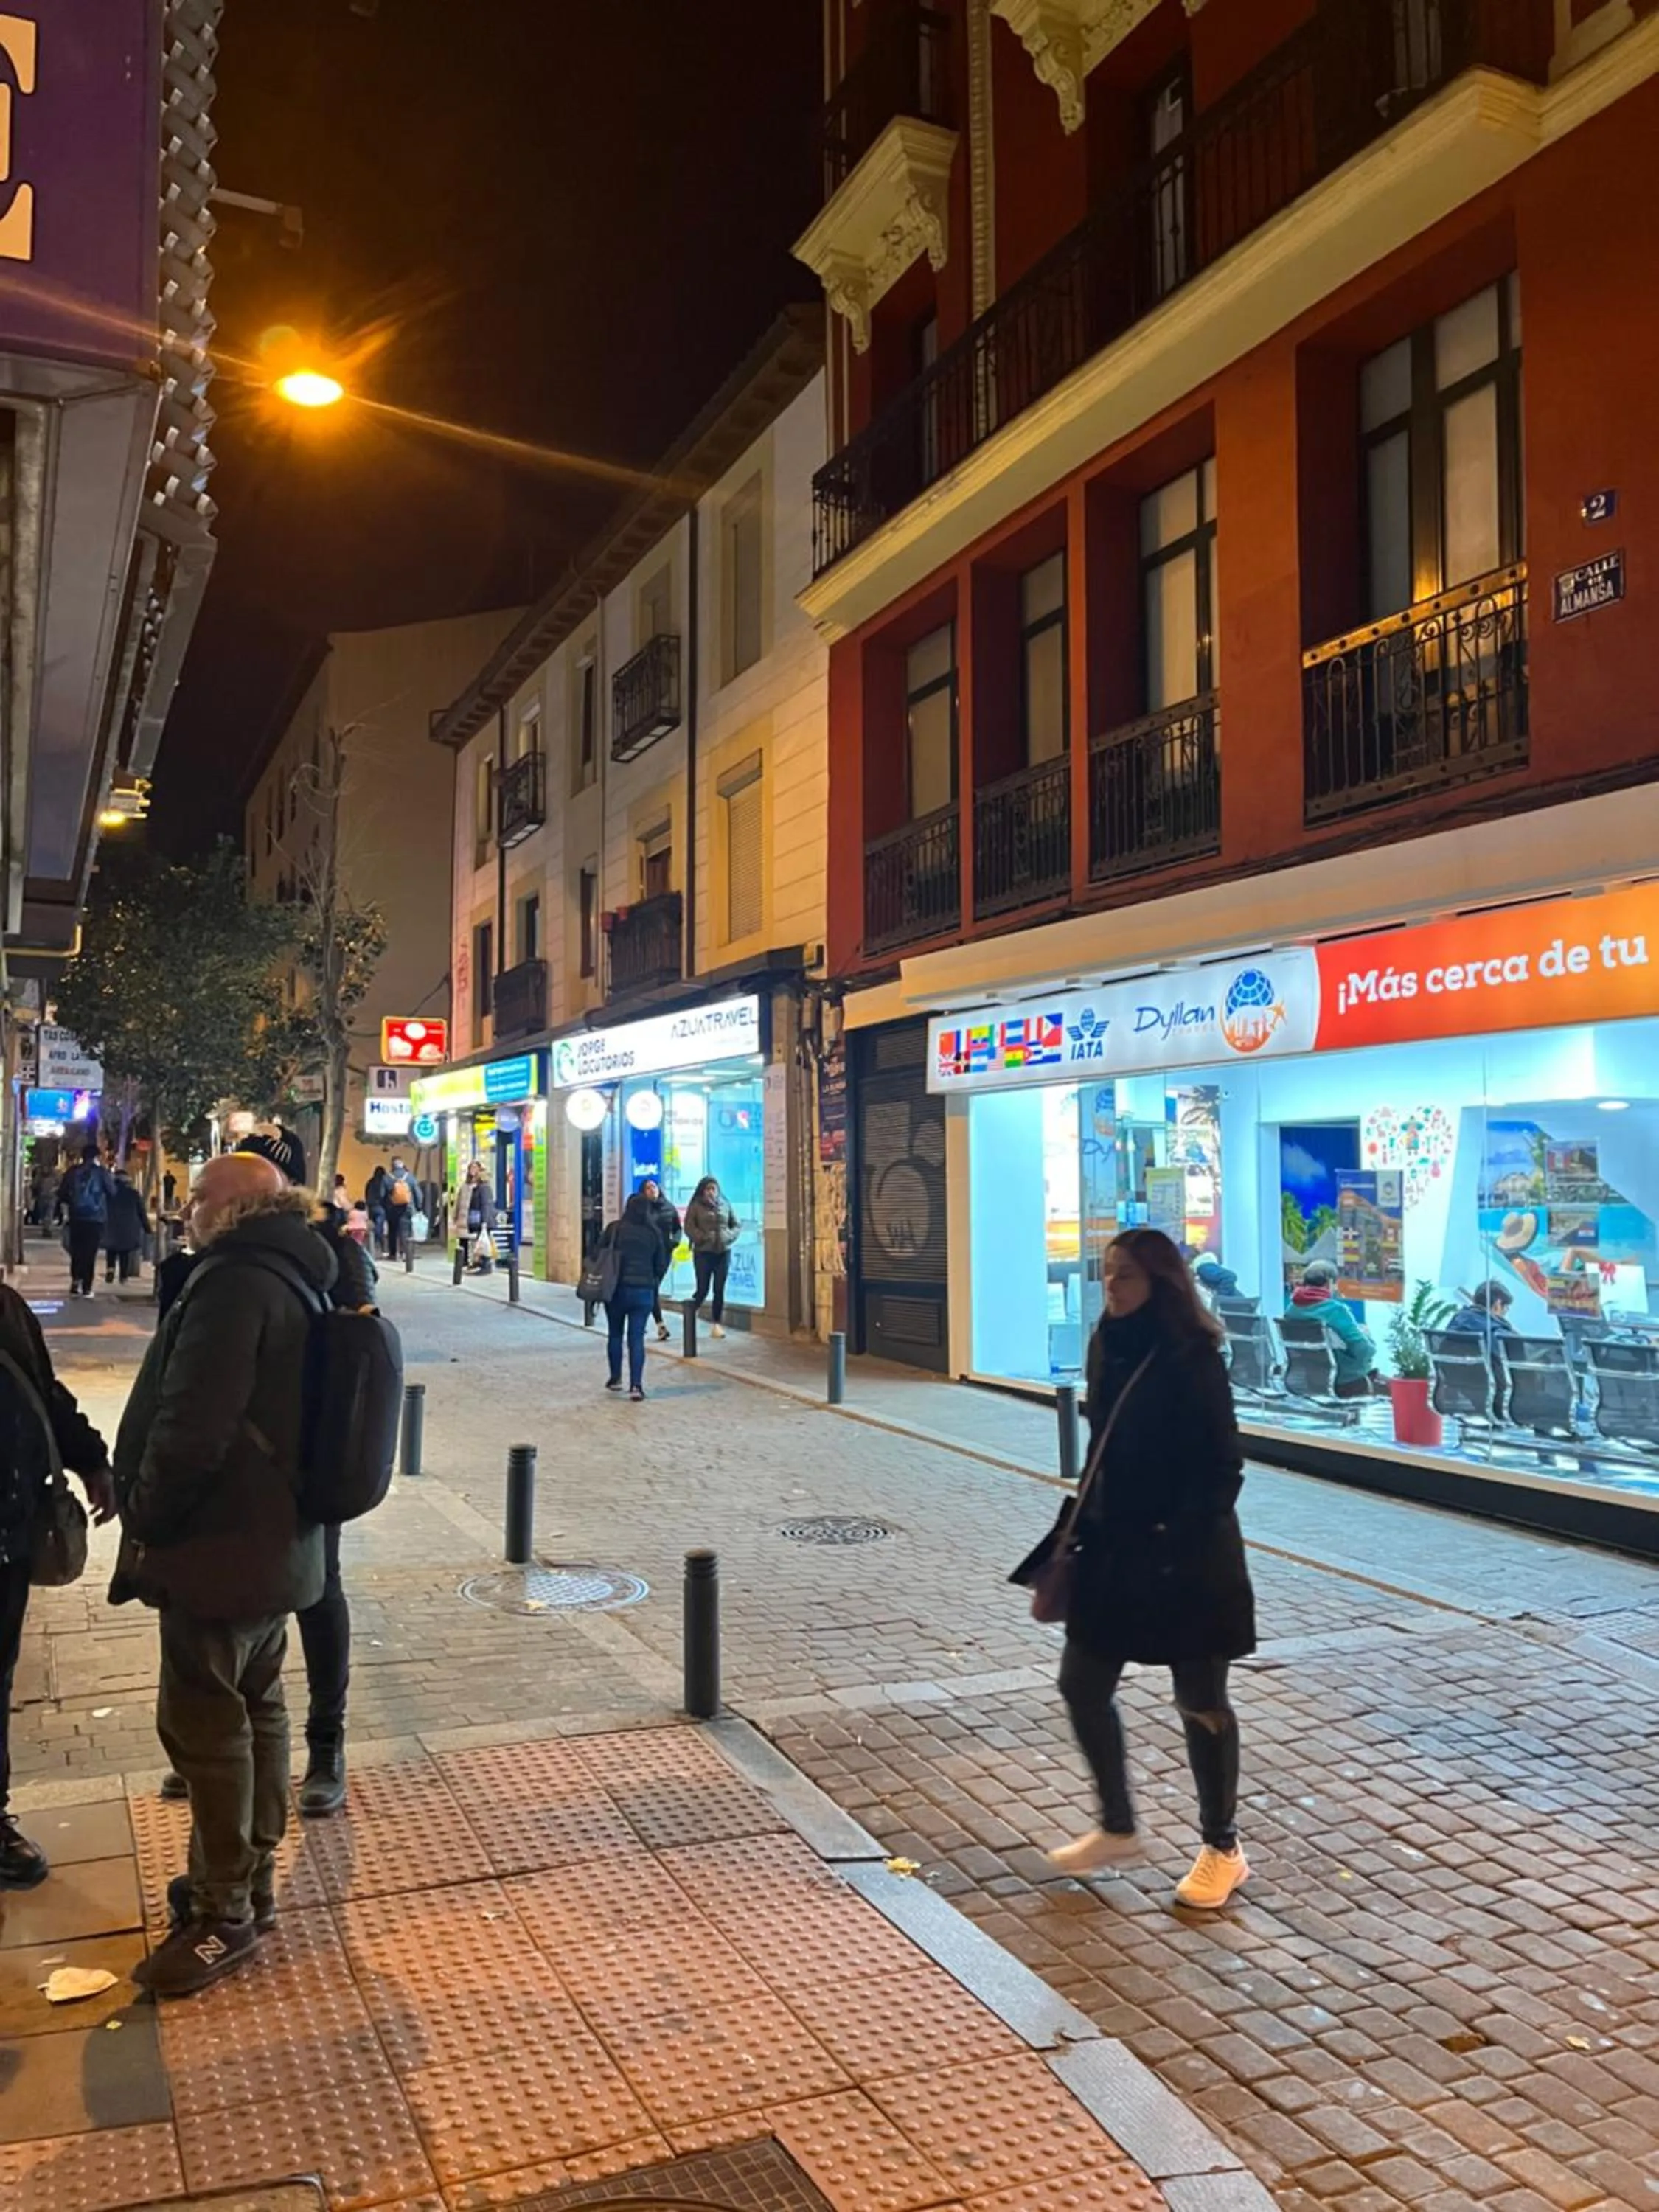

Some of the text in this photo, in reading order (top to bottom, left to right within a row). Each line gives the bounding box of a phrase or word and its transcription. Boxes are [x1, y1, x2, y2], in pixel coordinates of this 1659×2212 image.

[1590, 494, 1606, 519] 2
[1575, 555, 1619, 582] CALLE
[1559, 579, 1615, 616] ALMANSA
[1337, 935, 1649, 1014] ¡Más cerca de tu
[1133, 1001, 1215, 1040] Dyllan
[577, 1038, 605, 1057] JORGE
[1071, 1040, 1104, 1060] IATA
[370, 1100, 413, 1114] Hosta
[194, 1935, 228, 1964] N
